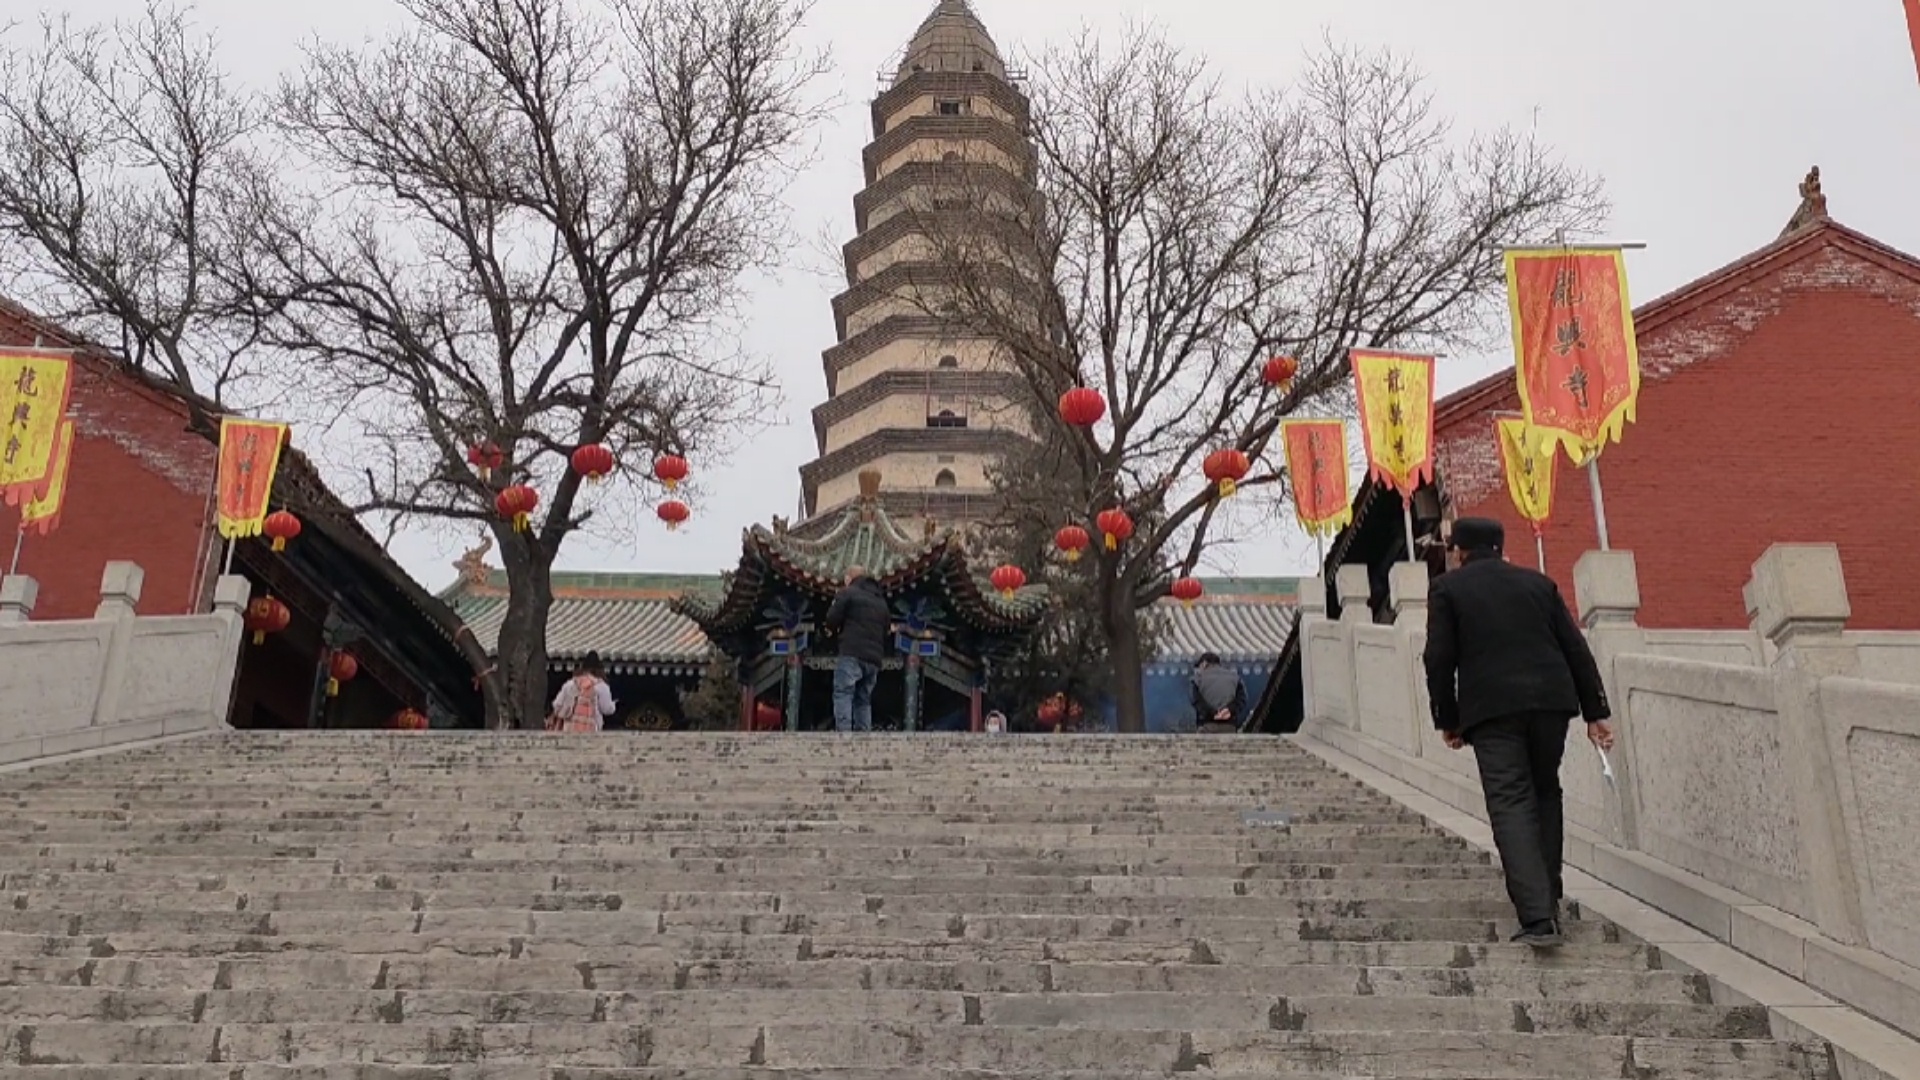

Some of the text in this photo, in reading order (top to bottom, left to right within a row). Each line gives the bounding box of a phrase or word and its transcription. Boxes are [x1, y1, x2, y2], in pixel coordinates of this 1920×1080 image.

[1549, 267, 1588, 409] 龍興寺
[4, 365, 39, 465] 龍興寺
